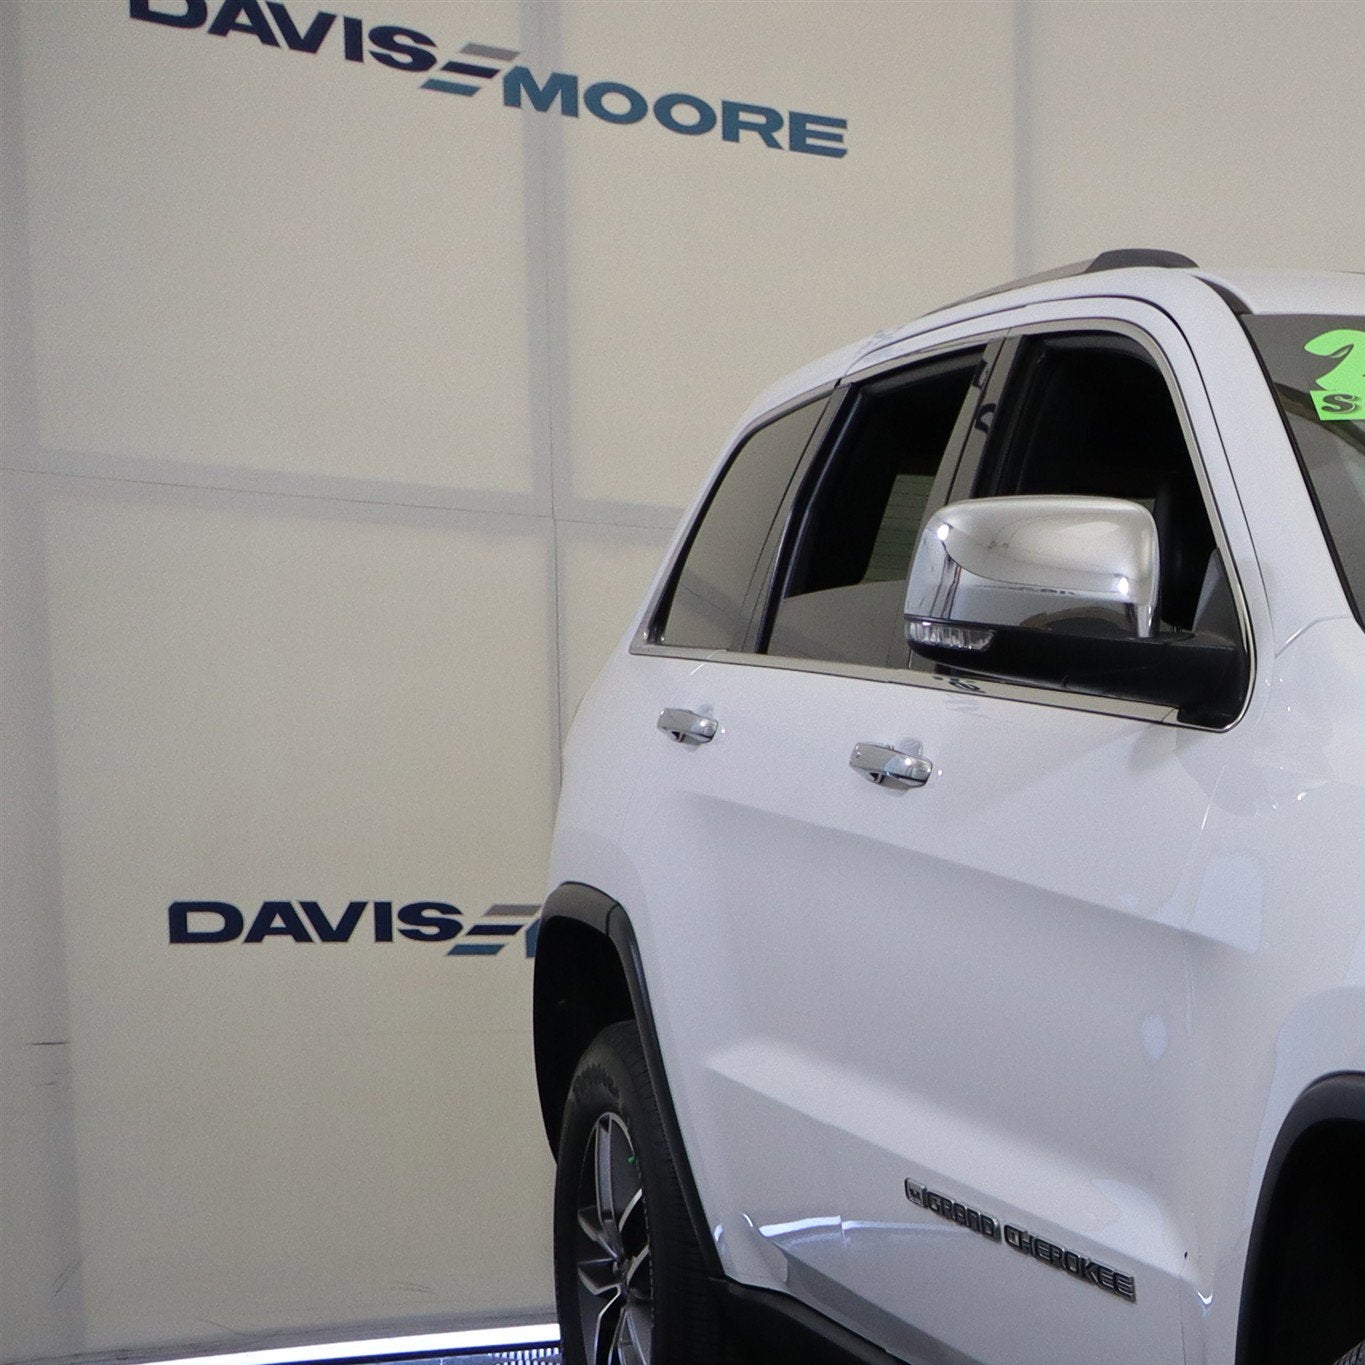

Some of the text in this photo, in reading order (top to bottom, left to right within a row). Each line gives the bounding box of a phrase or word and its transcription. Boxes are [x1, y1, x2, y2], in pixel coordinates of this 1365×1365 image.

[503, 66, 849, 159] MOORE
[168, 900, 464, 944] DAVIS
[1003, 1223, 1138, 1304] CHEROKEE
